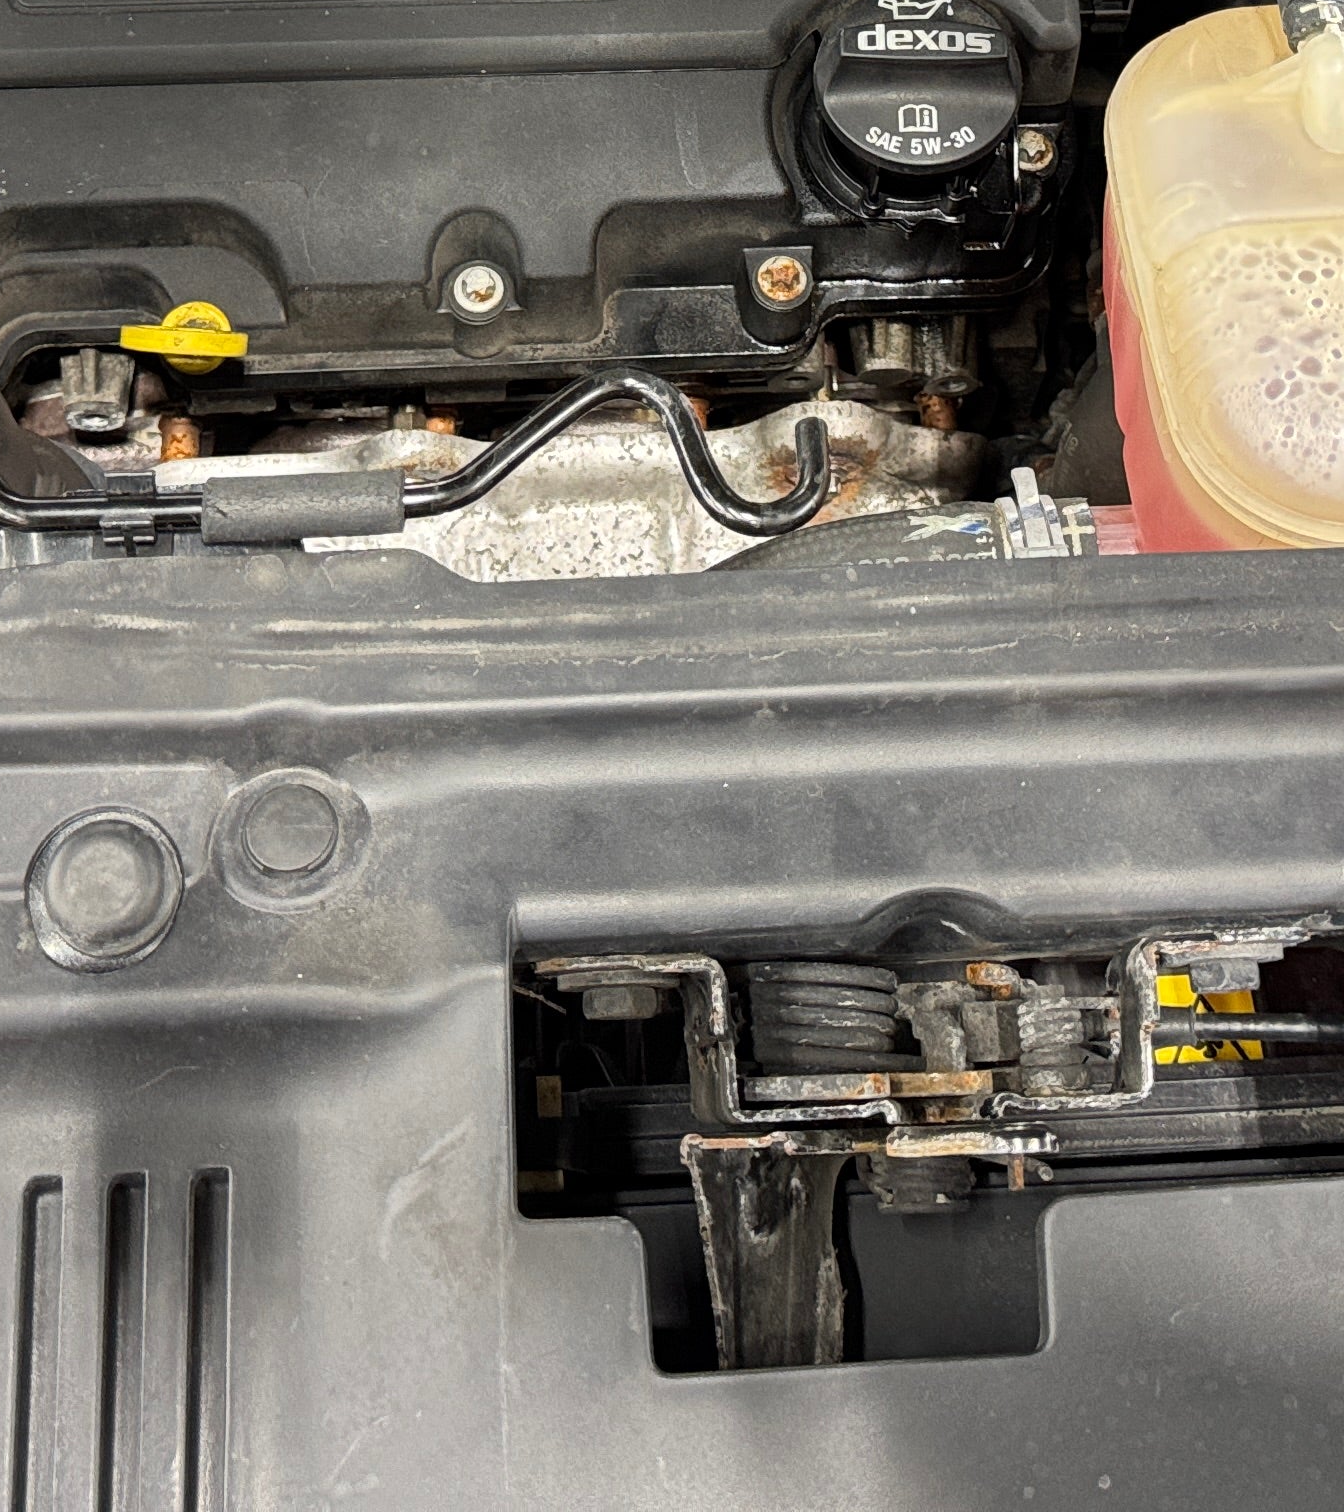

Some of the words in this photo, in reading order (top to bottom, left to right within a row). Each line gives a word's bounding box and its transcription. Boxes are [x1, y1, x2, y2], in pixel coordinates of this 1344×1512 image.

[857, 24, 992, 54] dexos
[865, 126, 904, 154] SAE
[910, 126, 976, 156] 5W-30
